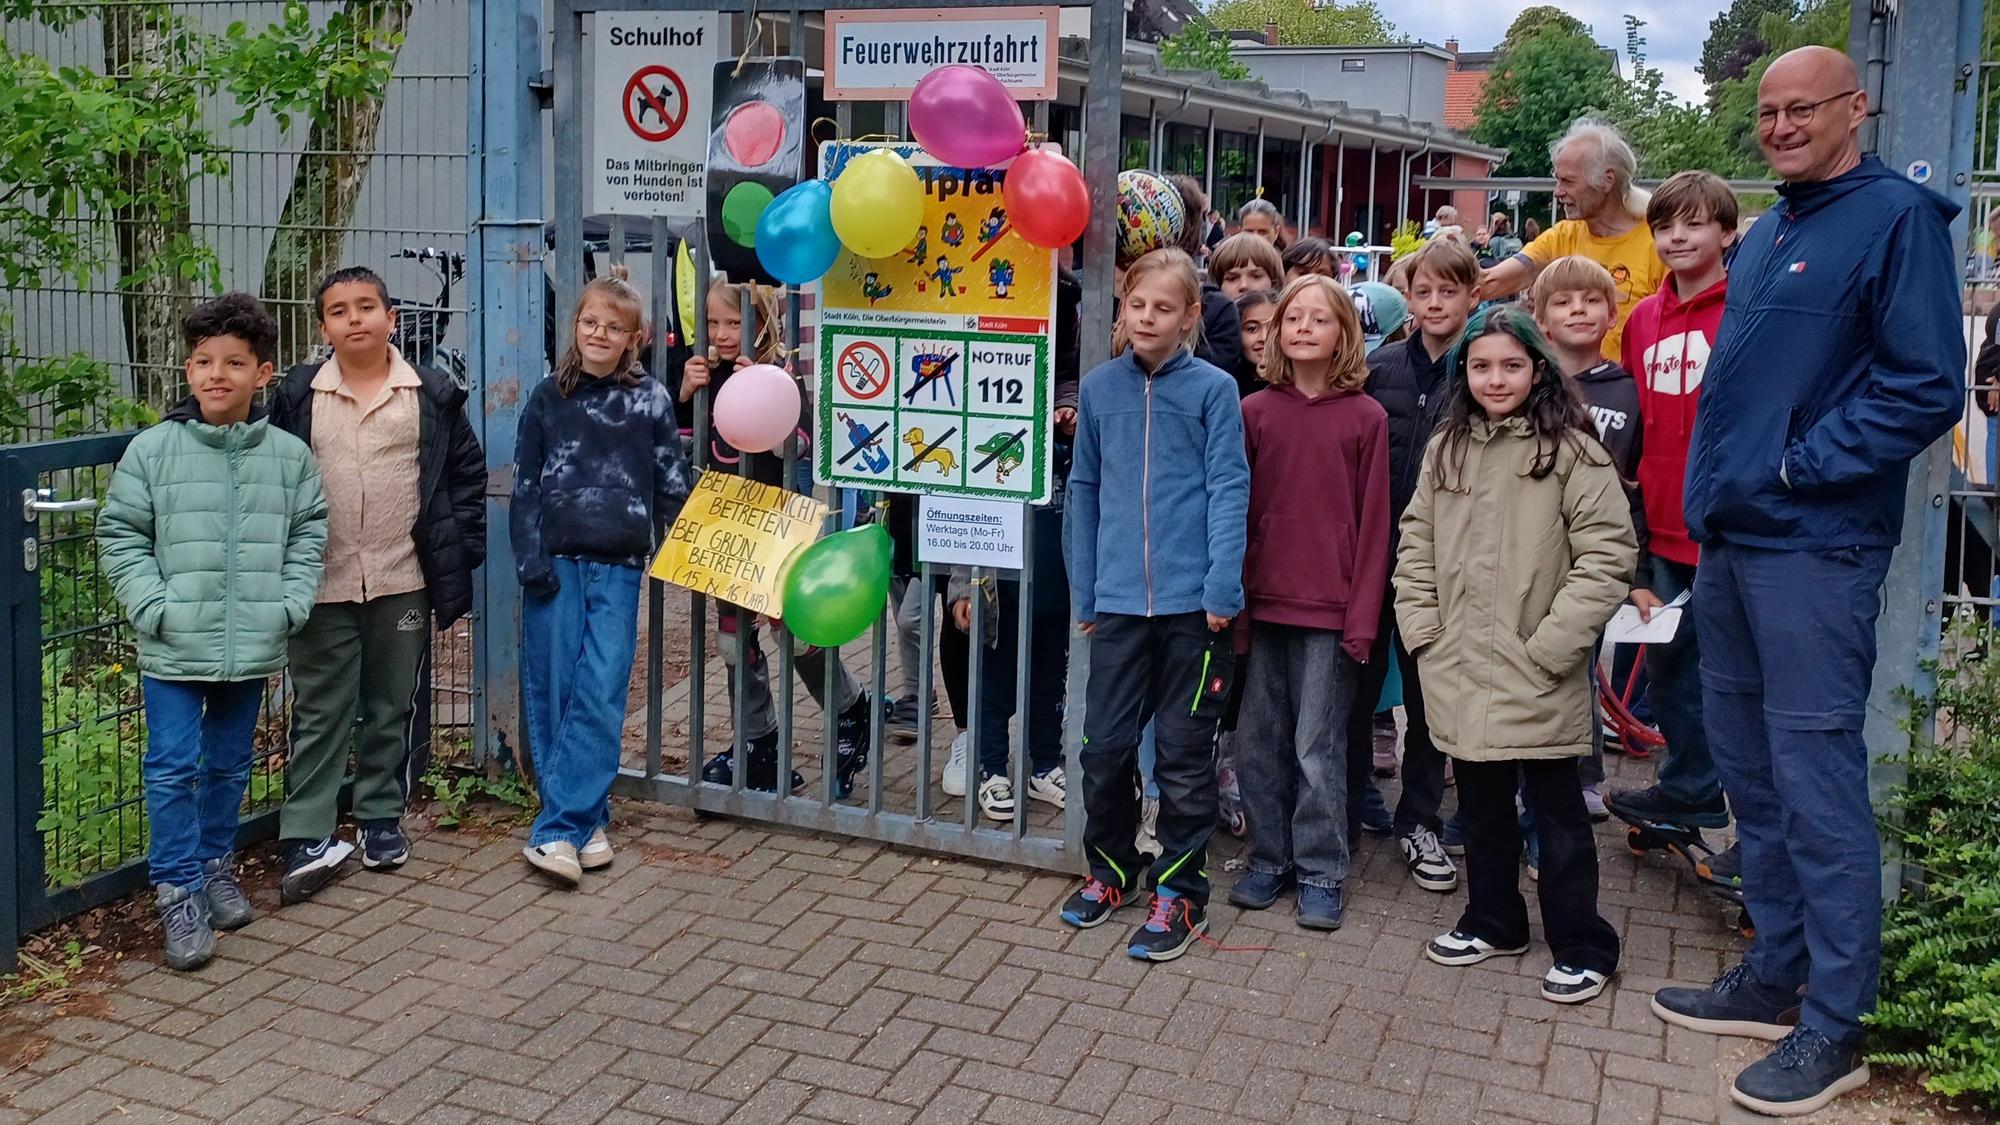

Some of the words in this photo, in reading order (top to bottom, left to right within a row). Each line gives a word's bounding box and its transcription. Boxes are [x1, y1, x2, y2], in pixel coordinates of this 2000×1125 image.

[610, 27, 703, 46] Schulhof
[843, 35, 1038, 64] Feuerwehrzufahrt
[606, 159, 629, 171] Das
[635, 159, 703, 175] Mitbringen
[606, 176, 628, 185] von
[634, 175, 683, 187] Hunden
[687, 176, 703, 188] ist
[624, 190, 684, 202] verboten!
[972, 351, 1031, 366] NOTRUF
[978, 377, 1023, 404] 112
[700, 471, 730, 494] BEI
[736, 479, 767, 503] ROT
[773, 488, 817, 524] NICHT
[709, 497, 791, 539] BETRETEN
[926, 507, 1003, 523] Öffnungszeiten:
[671, 518, 703, 544] BEI
[709, 530, 757, 561] GRÜN
[926, 523, 968, 537] Werktags
[970, 526, 1005, 539] (Mo-Fr)
[927, 538, 951, 548] 16.00
[953, 540, 967, 549] bis
[969, 541, 994, 551] 20.00
[997, 544, 1014, 552] Uhr
[689, 547, 765, 583] BETRETEN
[726, 584, 739, 602] 16
[743, 591, 770, 614] UHR)
